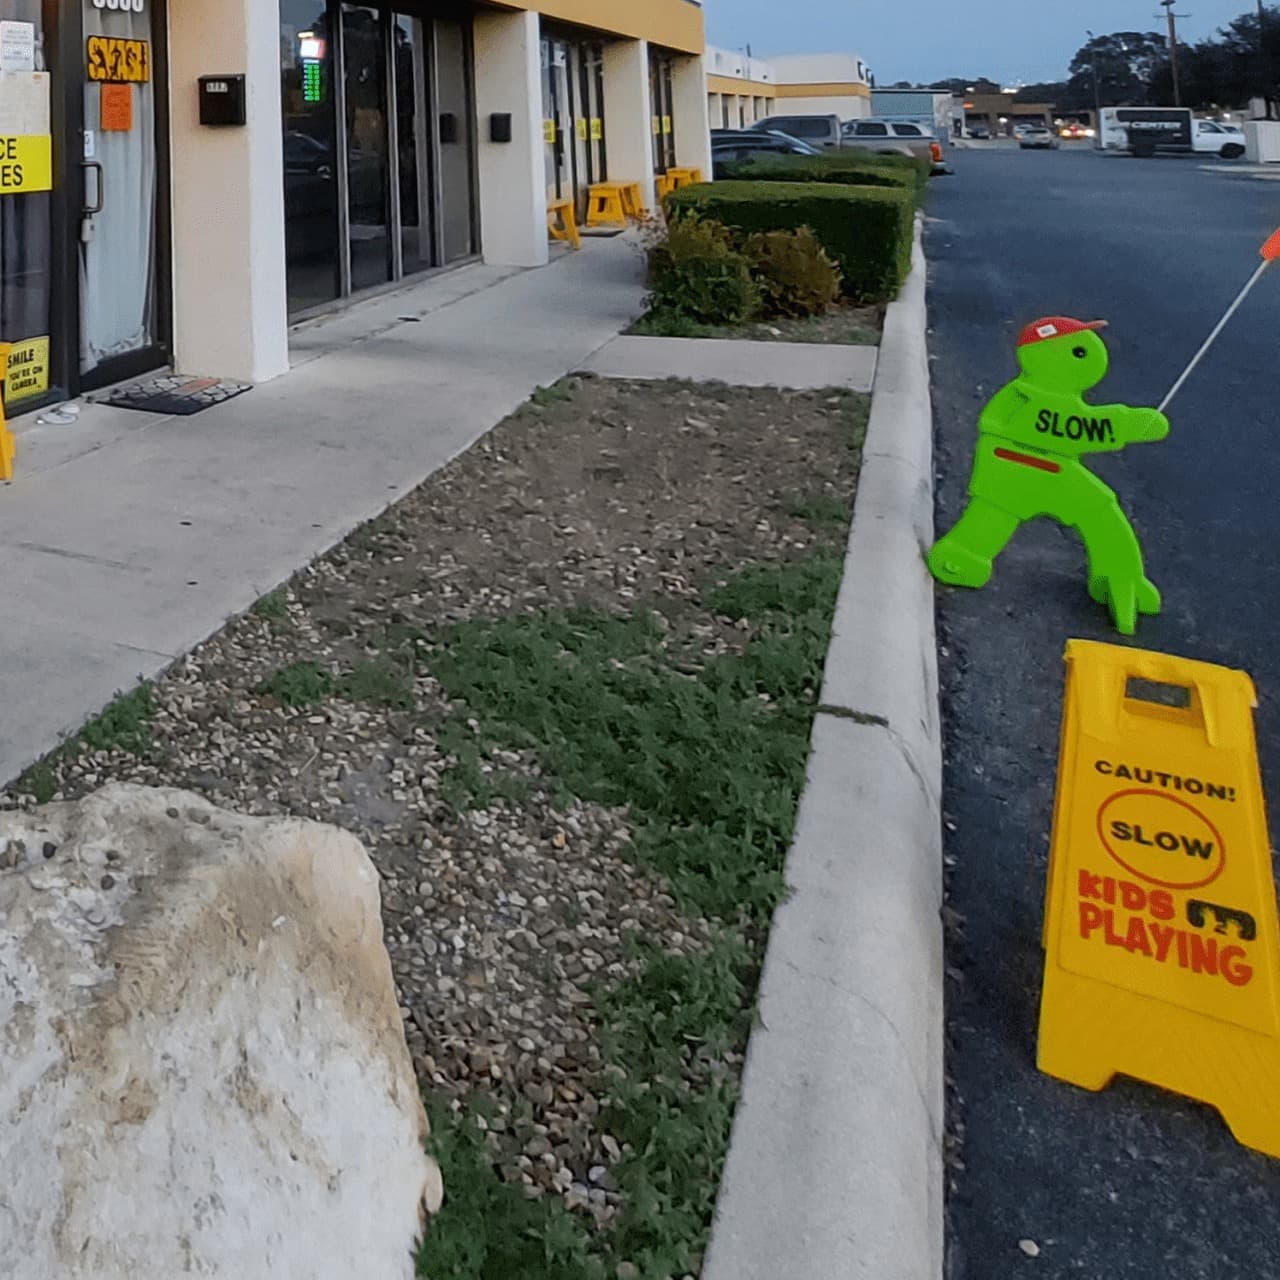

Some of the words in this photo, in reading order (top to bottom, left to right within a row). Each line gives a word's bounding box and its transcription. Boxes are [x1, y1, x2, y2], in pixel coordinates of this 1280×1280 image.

[7, 348, 35, 369] SMILE
[1035, 409, 1116, 443] SLOW!
[1094, 759, 1236, 802] CAUTION!
[1110, 821, 1214, 860] SLOW
[1078, 869, 1176, 921] KIDS
[1078, 901, 1253, 987] PLAYING
